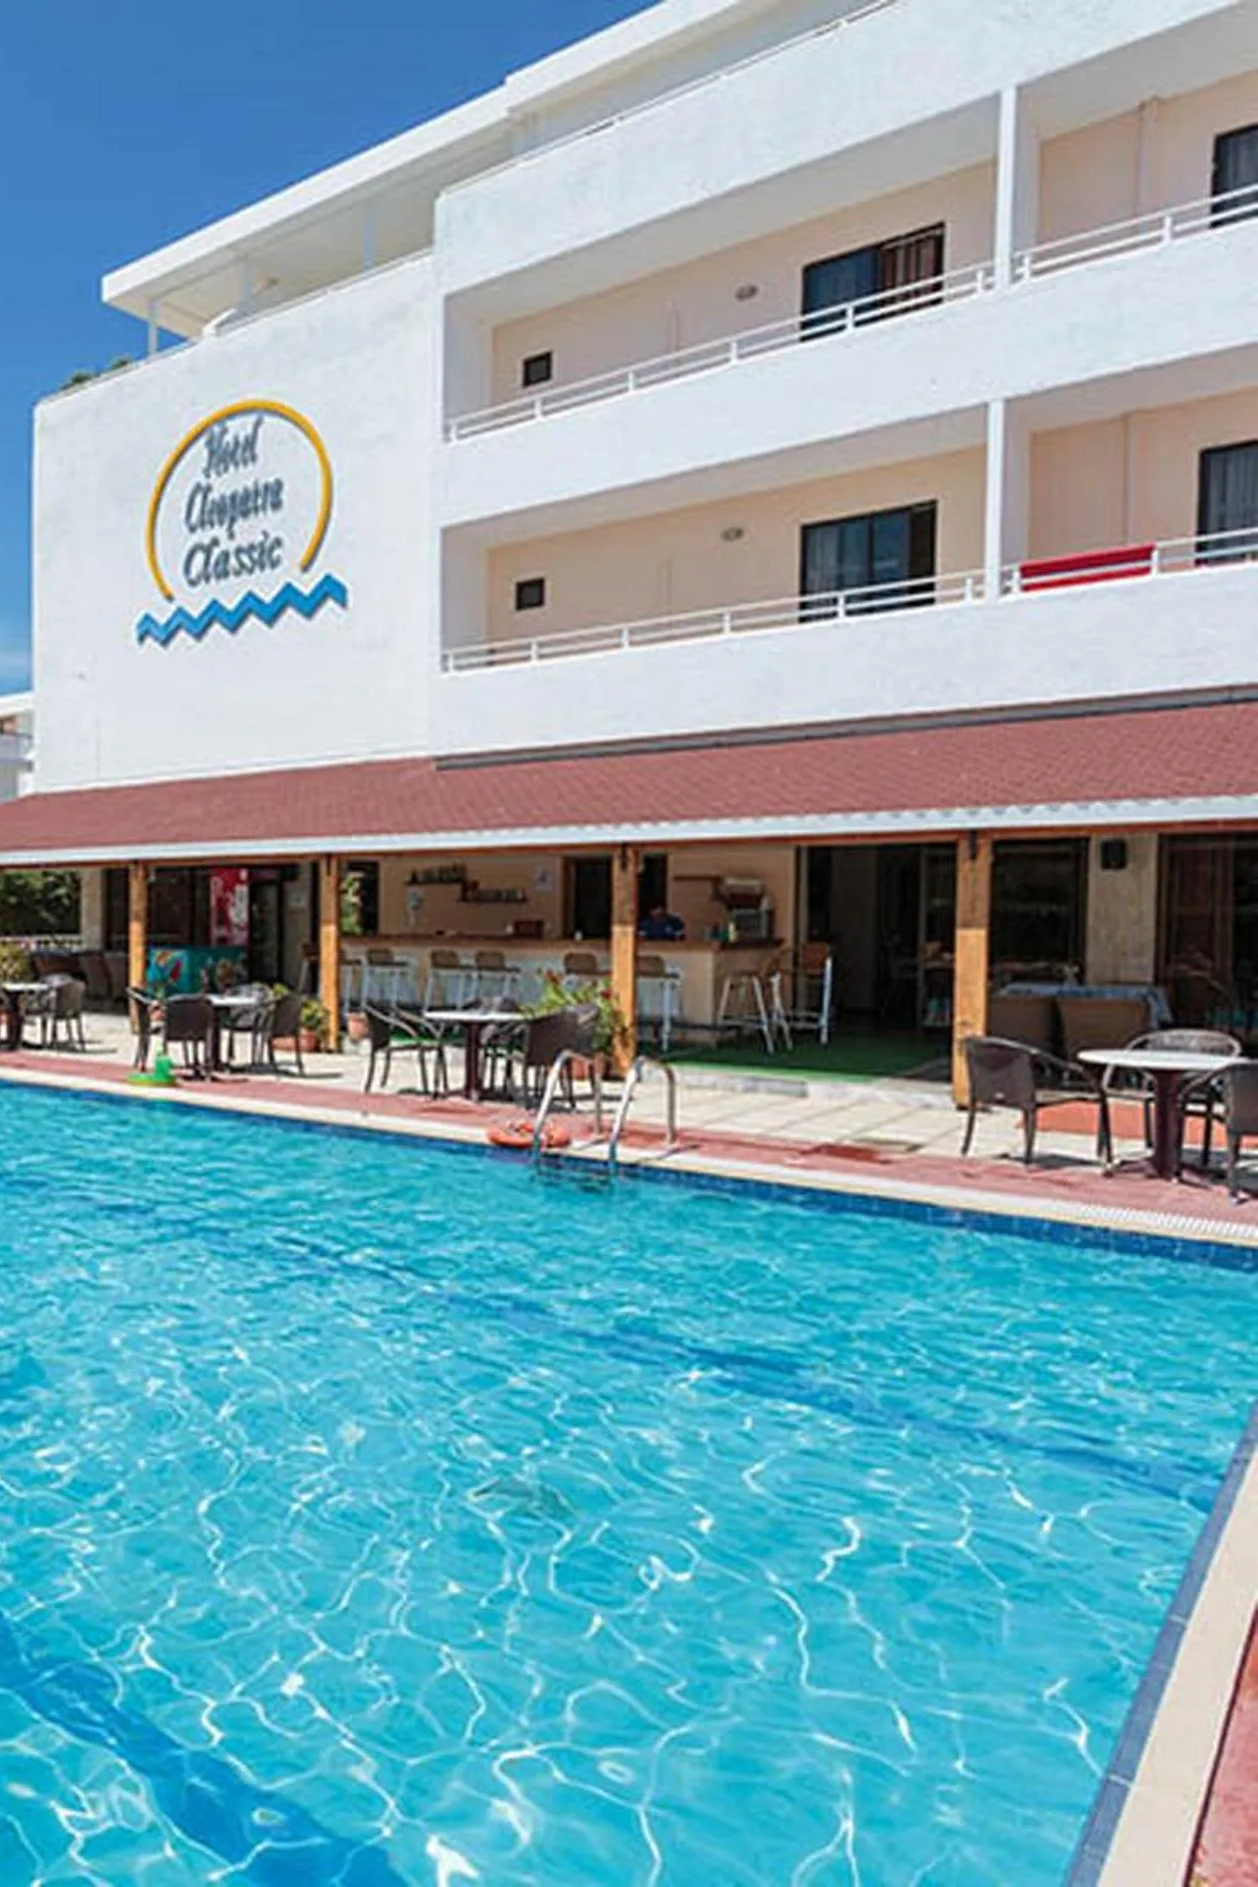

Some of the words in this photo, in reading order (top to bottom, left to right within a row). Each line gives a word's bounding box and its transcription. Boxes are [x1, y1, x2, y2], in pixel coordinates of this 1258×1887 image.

[202, 415, 264, 479] Hotel
[184, 478, 285, 541] Cleopatra
[182, 529, 284, 588] Classic
